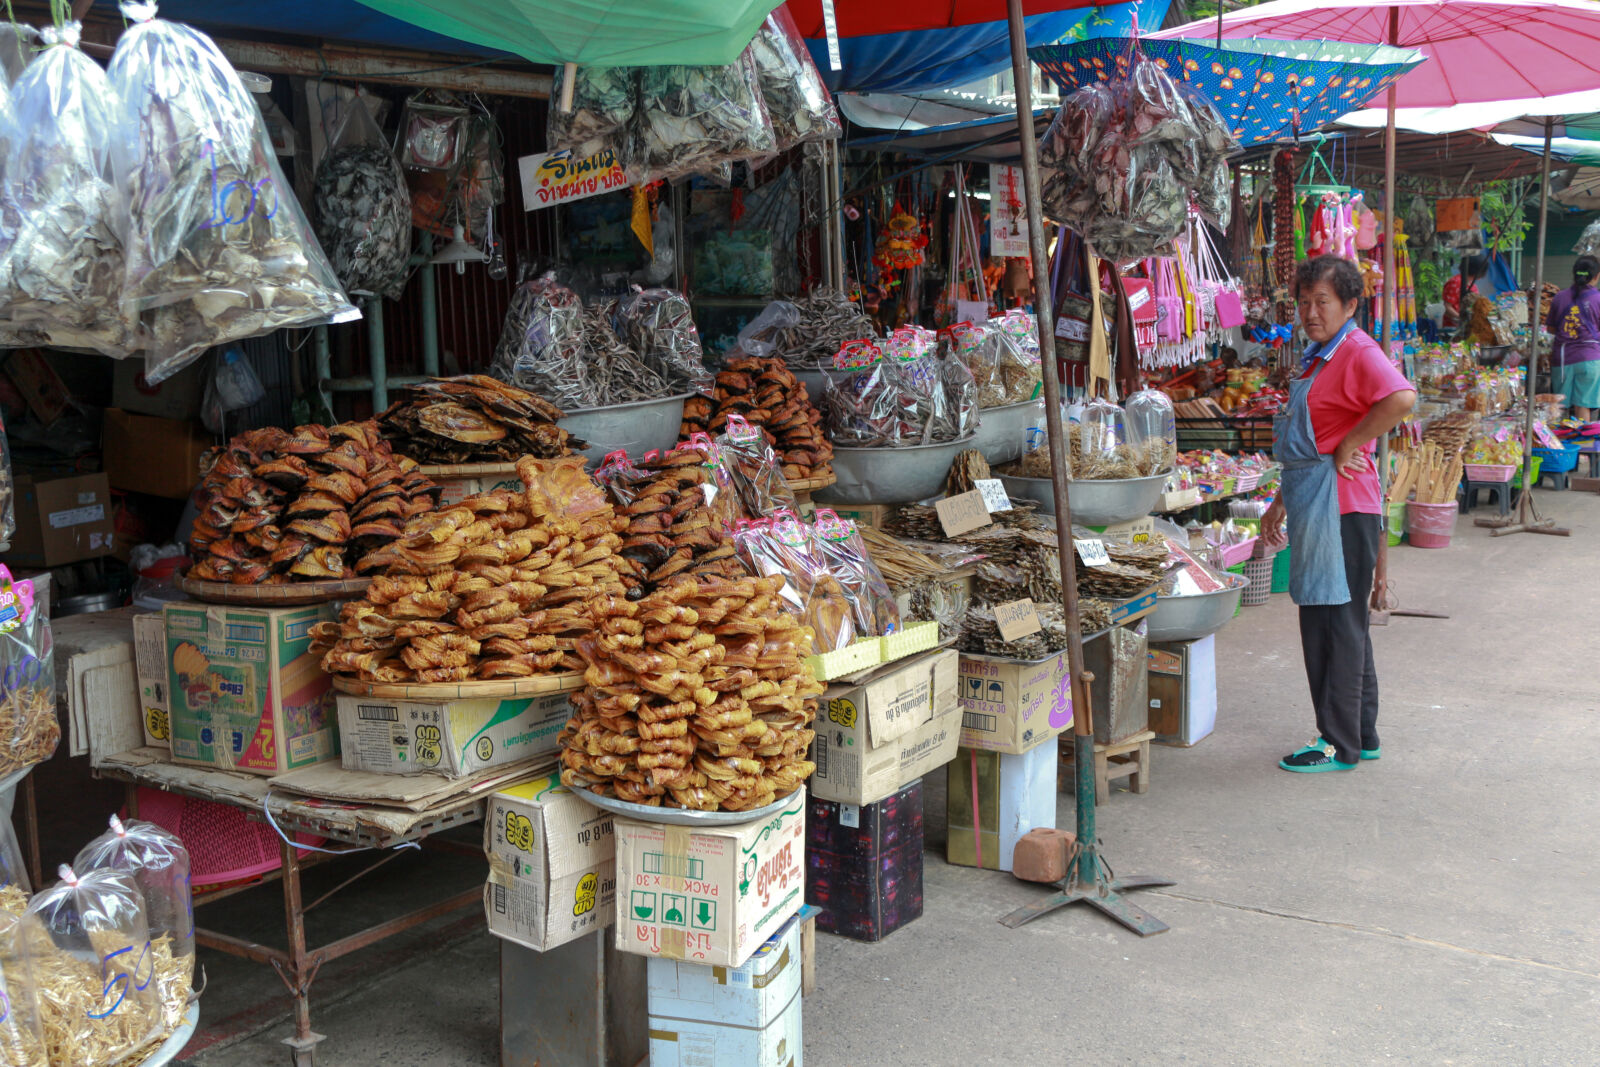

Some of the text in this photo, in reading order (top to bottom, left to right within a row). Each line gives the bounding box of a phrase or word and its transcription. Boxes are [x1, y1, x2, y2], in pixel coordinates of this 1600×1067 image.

[199, 139, 278, 230] 100
[535, 166, 628, 204] จำหน่าย ปลี
[219, 681, 244, 695] Elise
[260, 728, 274, 760] 2
[593, 826, 601, 840] 8
[636, 873, 650, 887] 30
[684, 879, 719, 897] PACK
[87, 941, 154, 1020] 50
